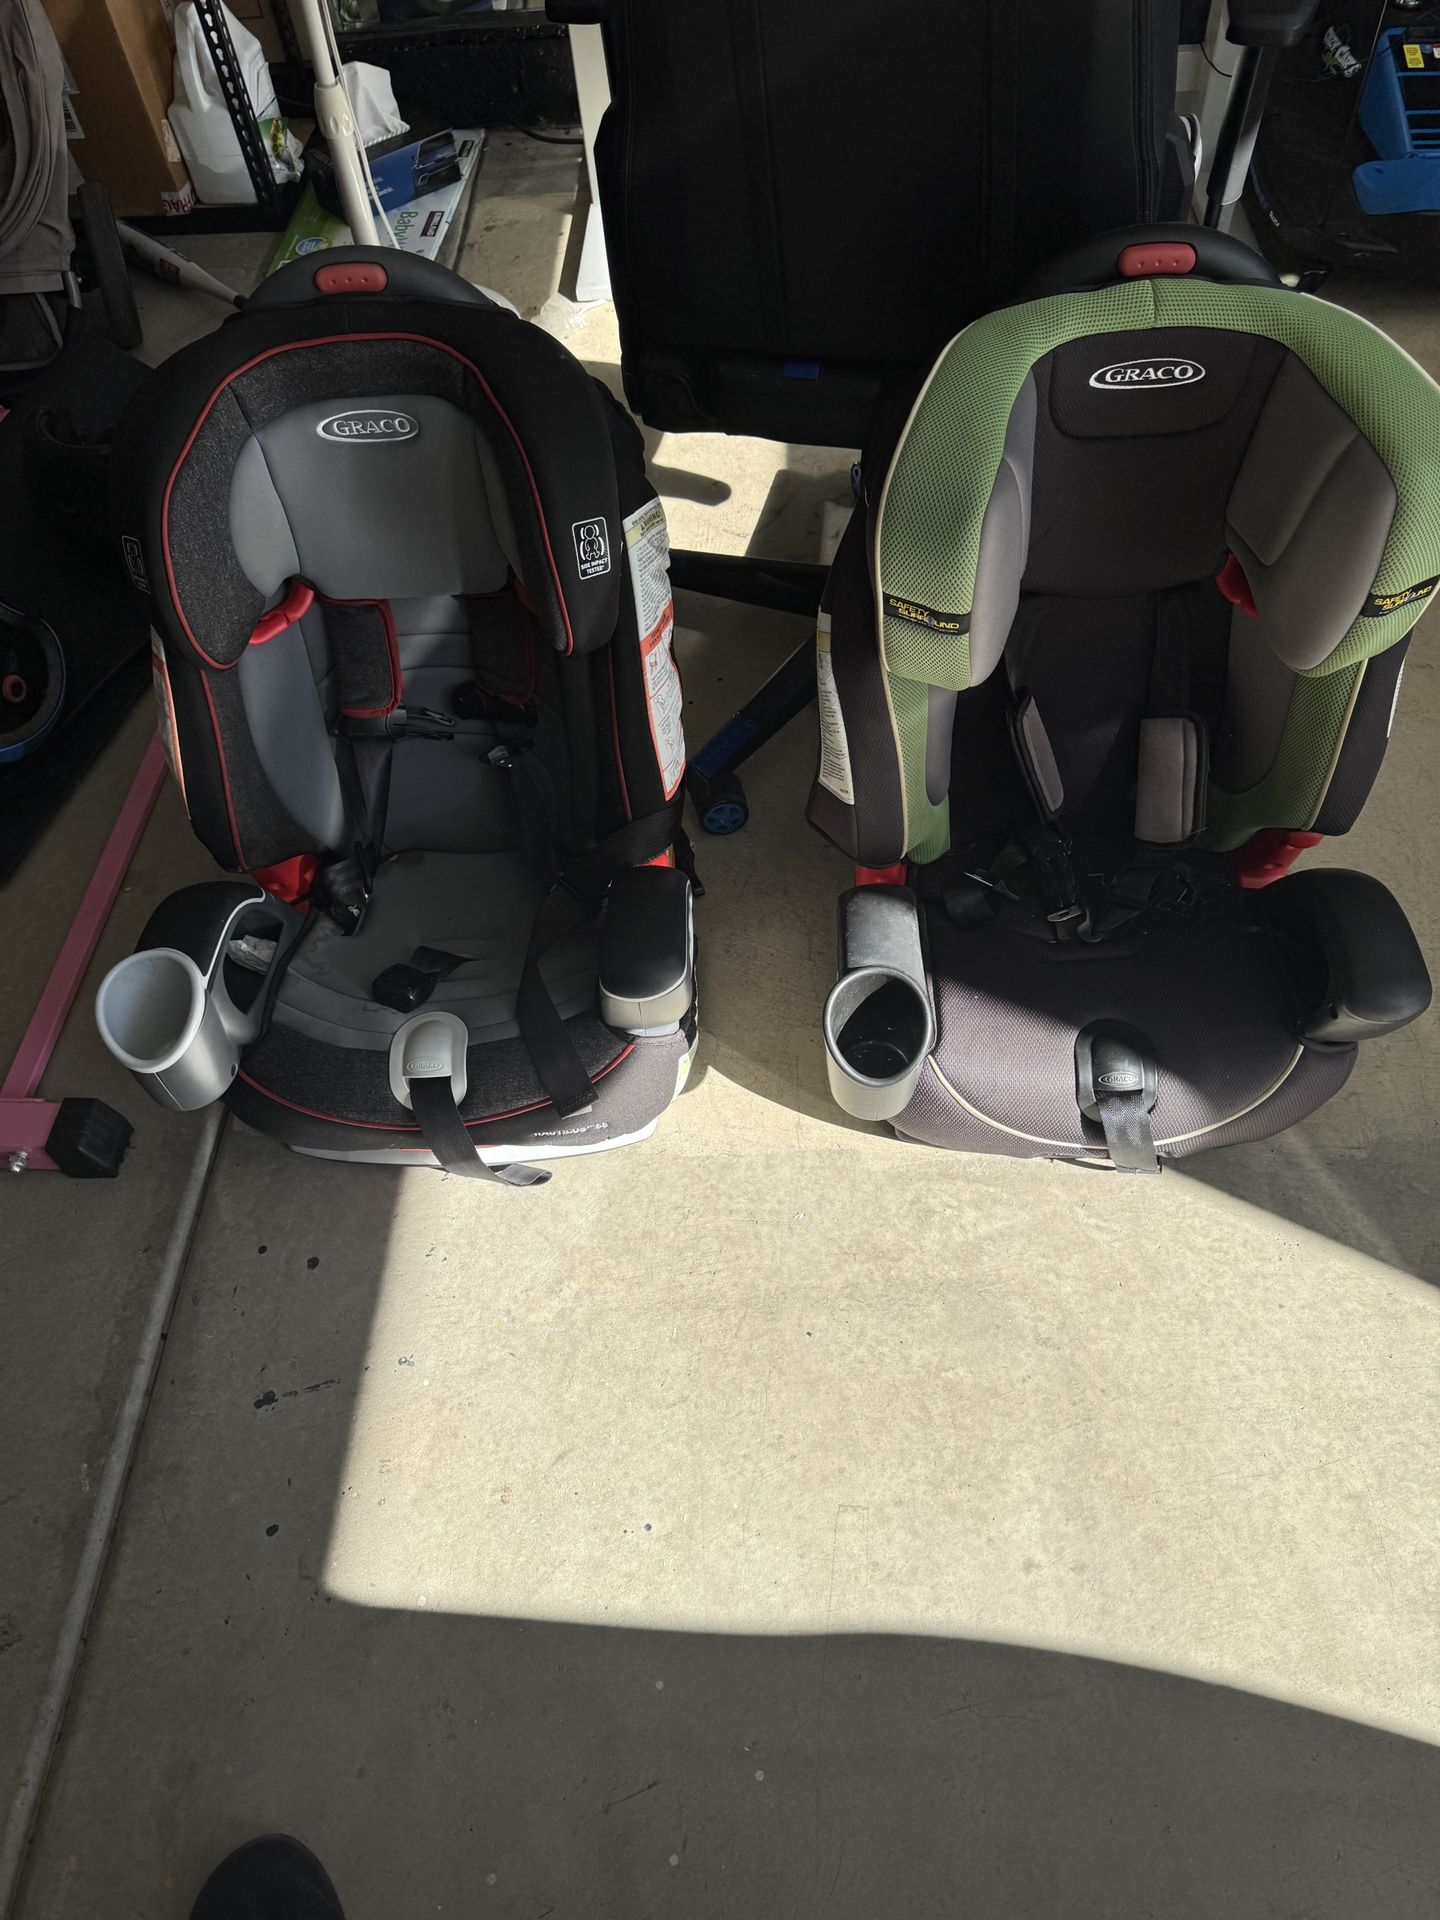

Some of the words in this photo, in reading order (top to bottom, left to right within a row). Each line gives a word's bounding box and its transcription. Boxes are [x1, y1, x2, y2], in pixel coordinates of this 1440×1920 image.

[1105, 365, 1193, 382] GRACO
[333, 417, 410, 435] GRACO
[889, 598, 930, 617] SAFETY
